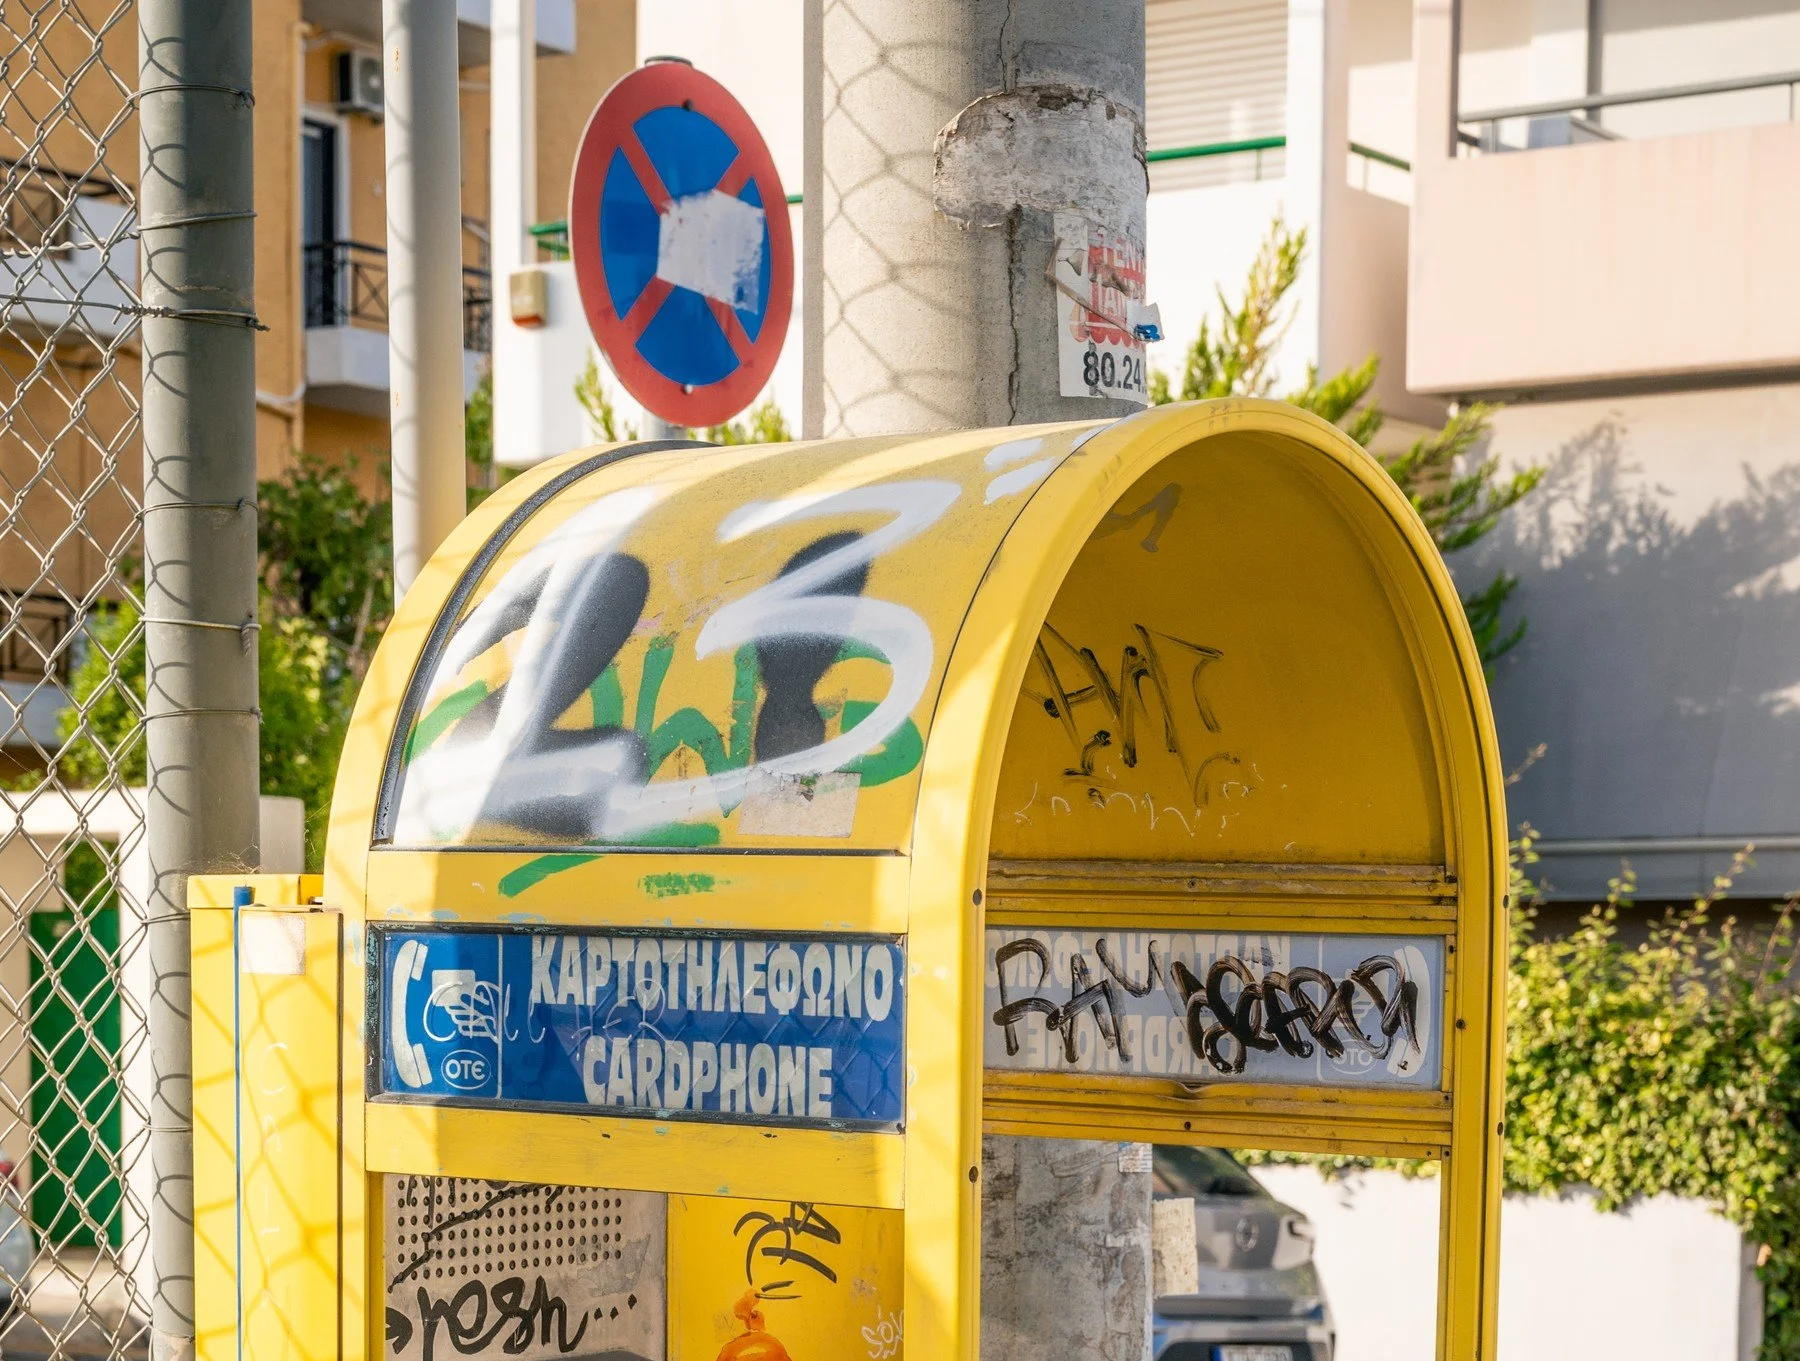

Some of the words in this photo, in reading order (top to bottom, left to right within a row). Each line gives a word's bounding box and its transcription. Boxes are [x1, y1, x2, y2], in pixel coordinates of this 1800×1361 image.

[531, 935, 893, 1021] ΚΑΡΤΟΤΗΛΕΦΩΝΟ
[445, 1059, 485, 1082] ΟΤΕ
[583, 1042, 833, 1117] CARDPHONE
